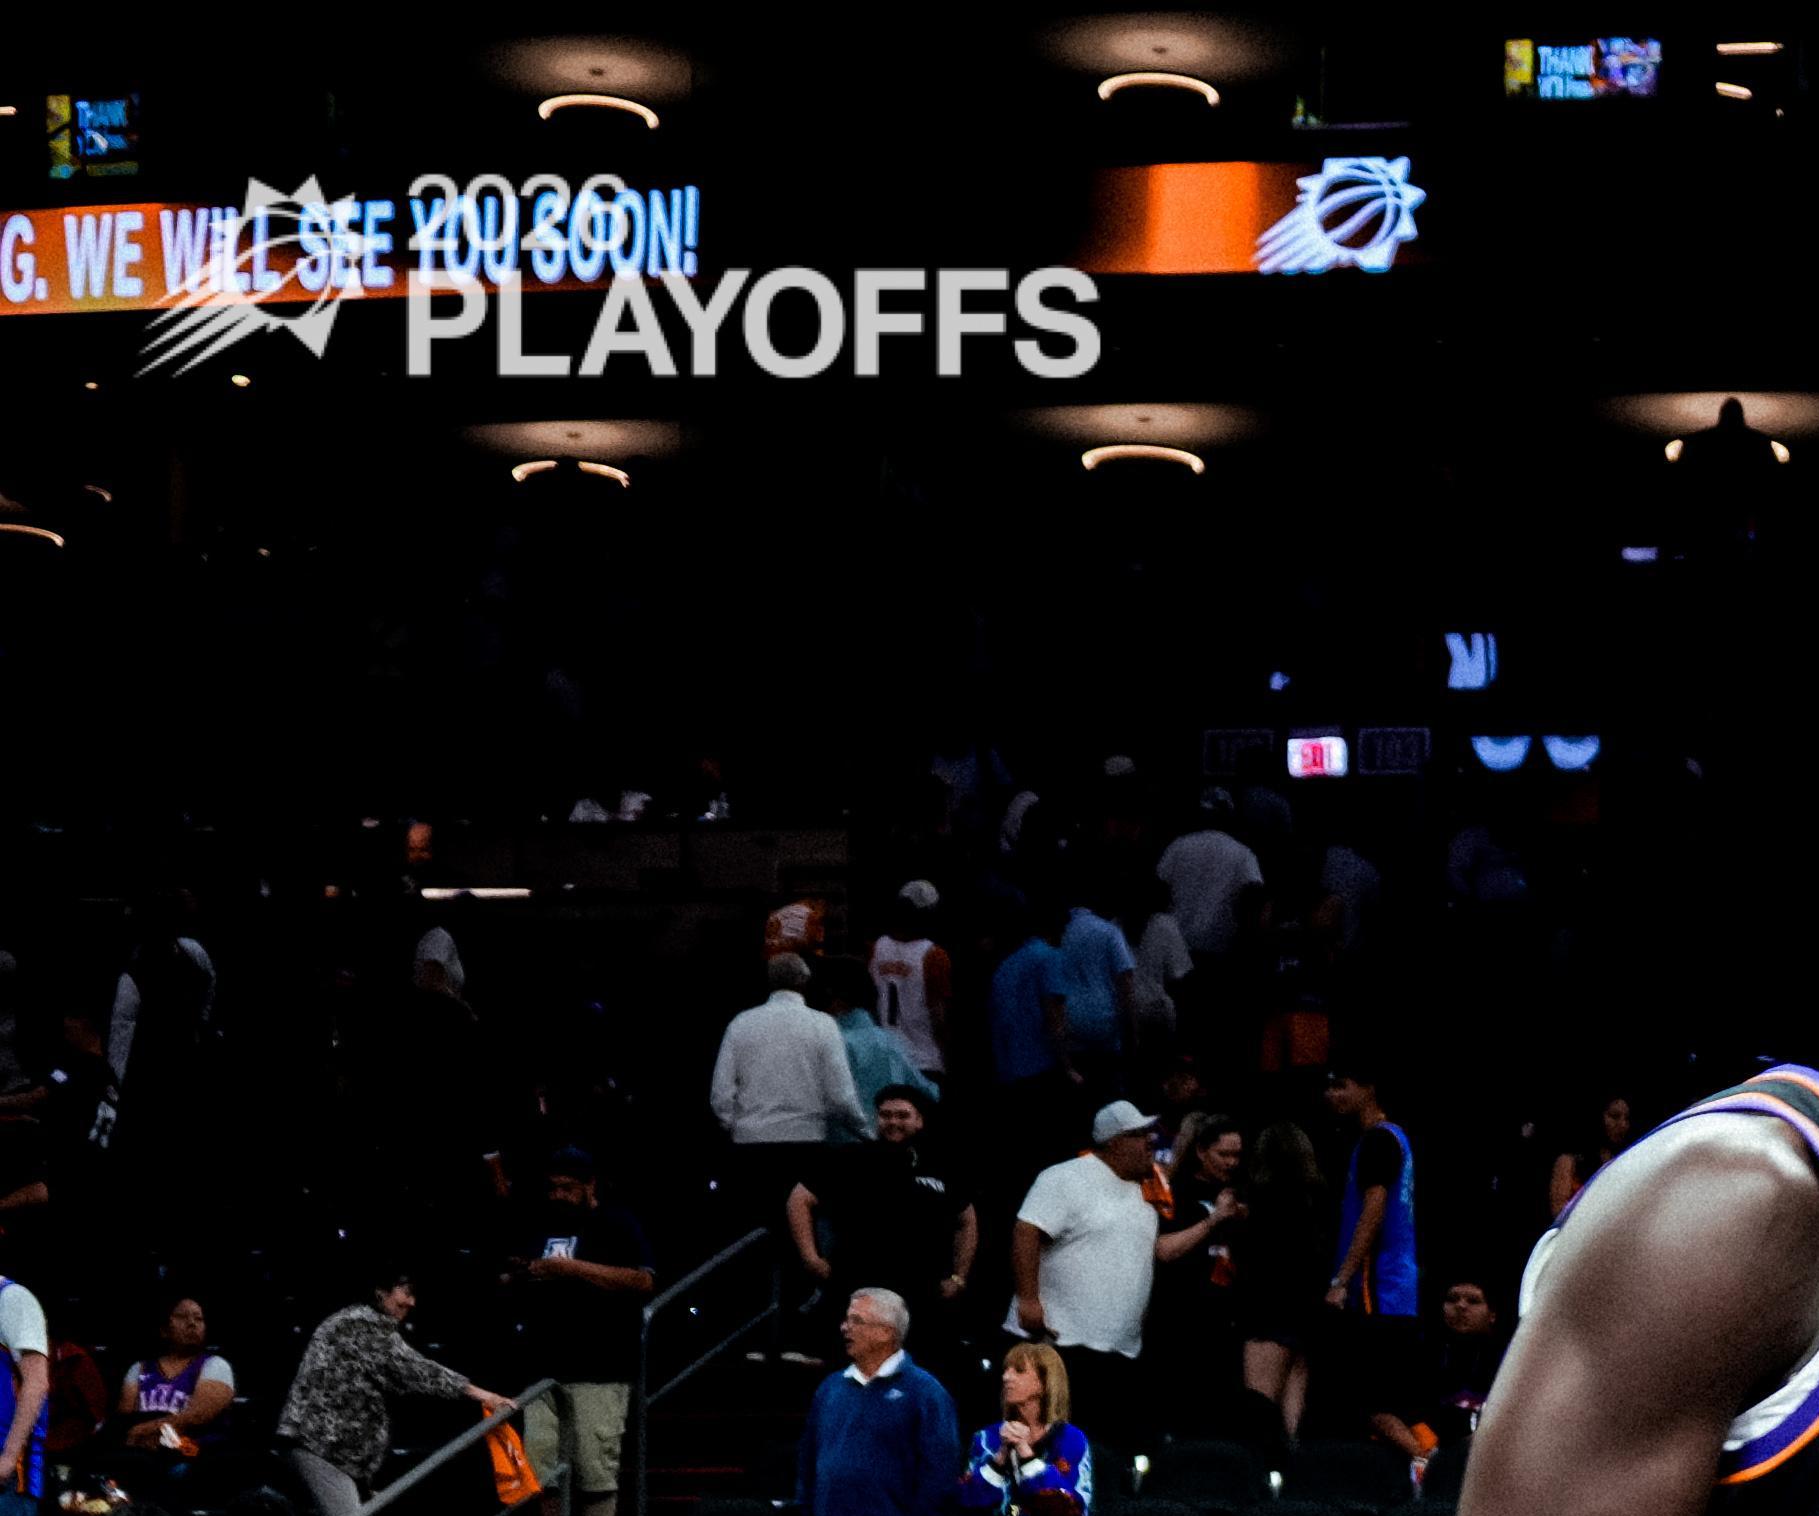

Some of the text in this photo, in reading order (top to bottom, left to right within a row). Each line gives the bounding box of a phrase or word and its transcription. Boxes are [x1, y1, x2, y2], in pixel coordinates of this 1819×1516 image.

[62, 210, 145, 301] WE
[297, 199, 395, 292] SEE
[409, 194, 519, 286] YOU
[531, 184, 700, 284] SOON!
